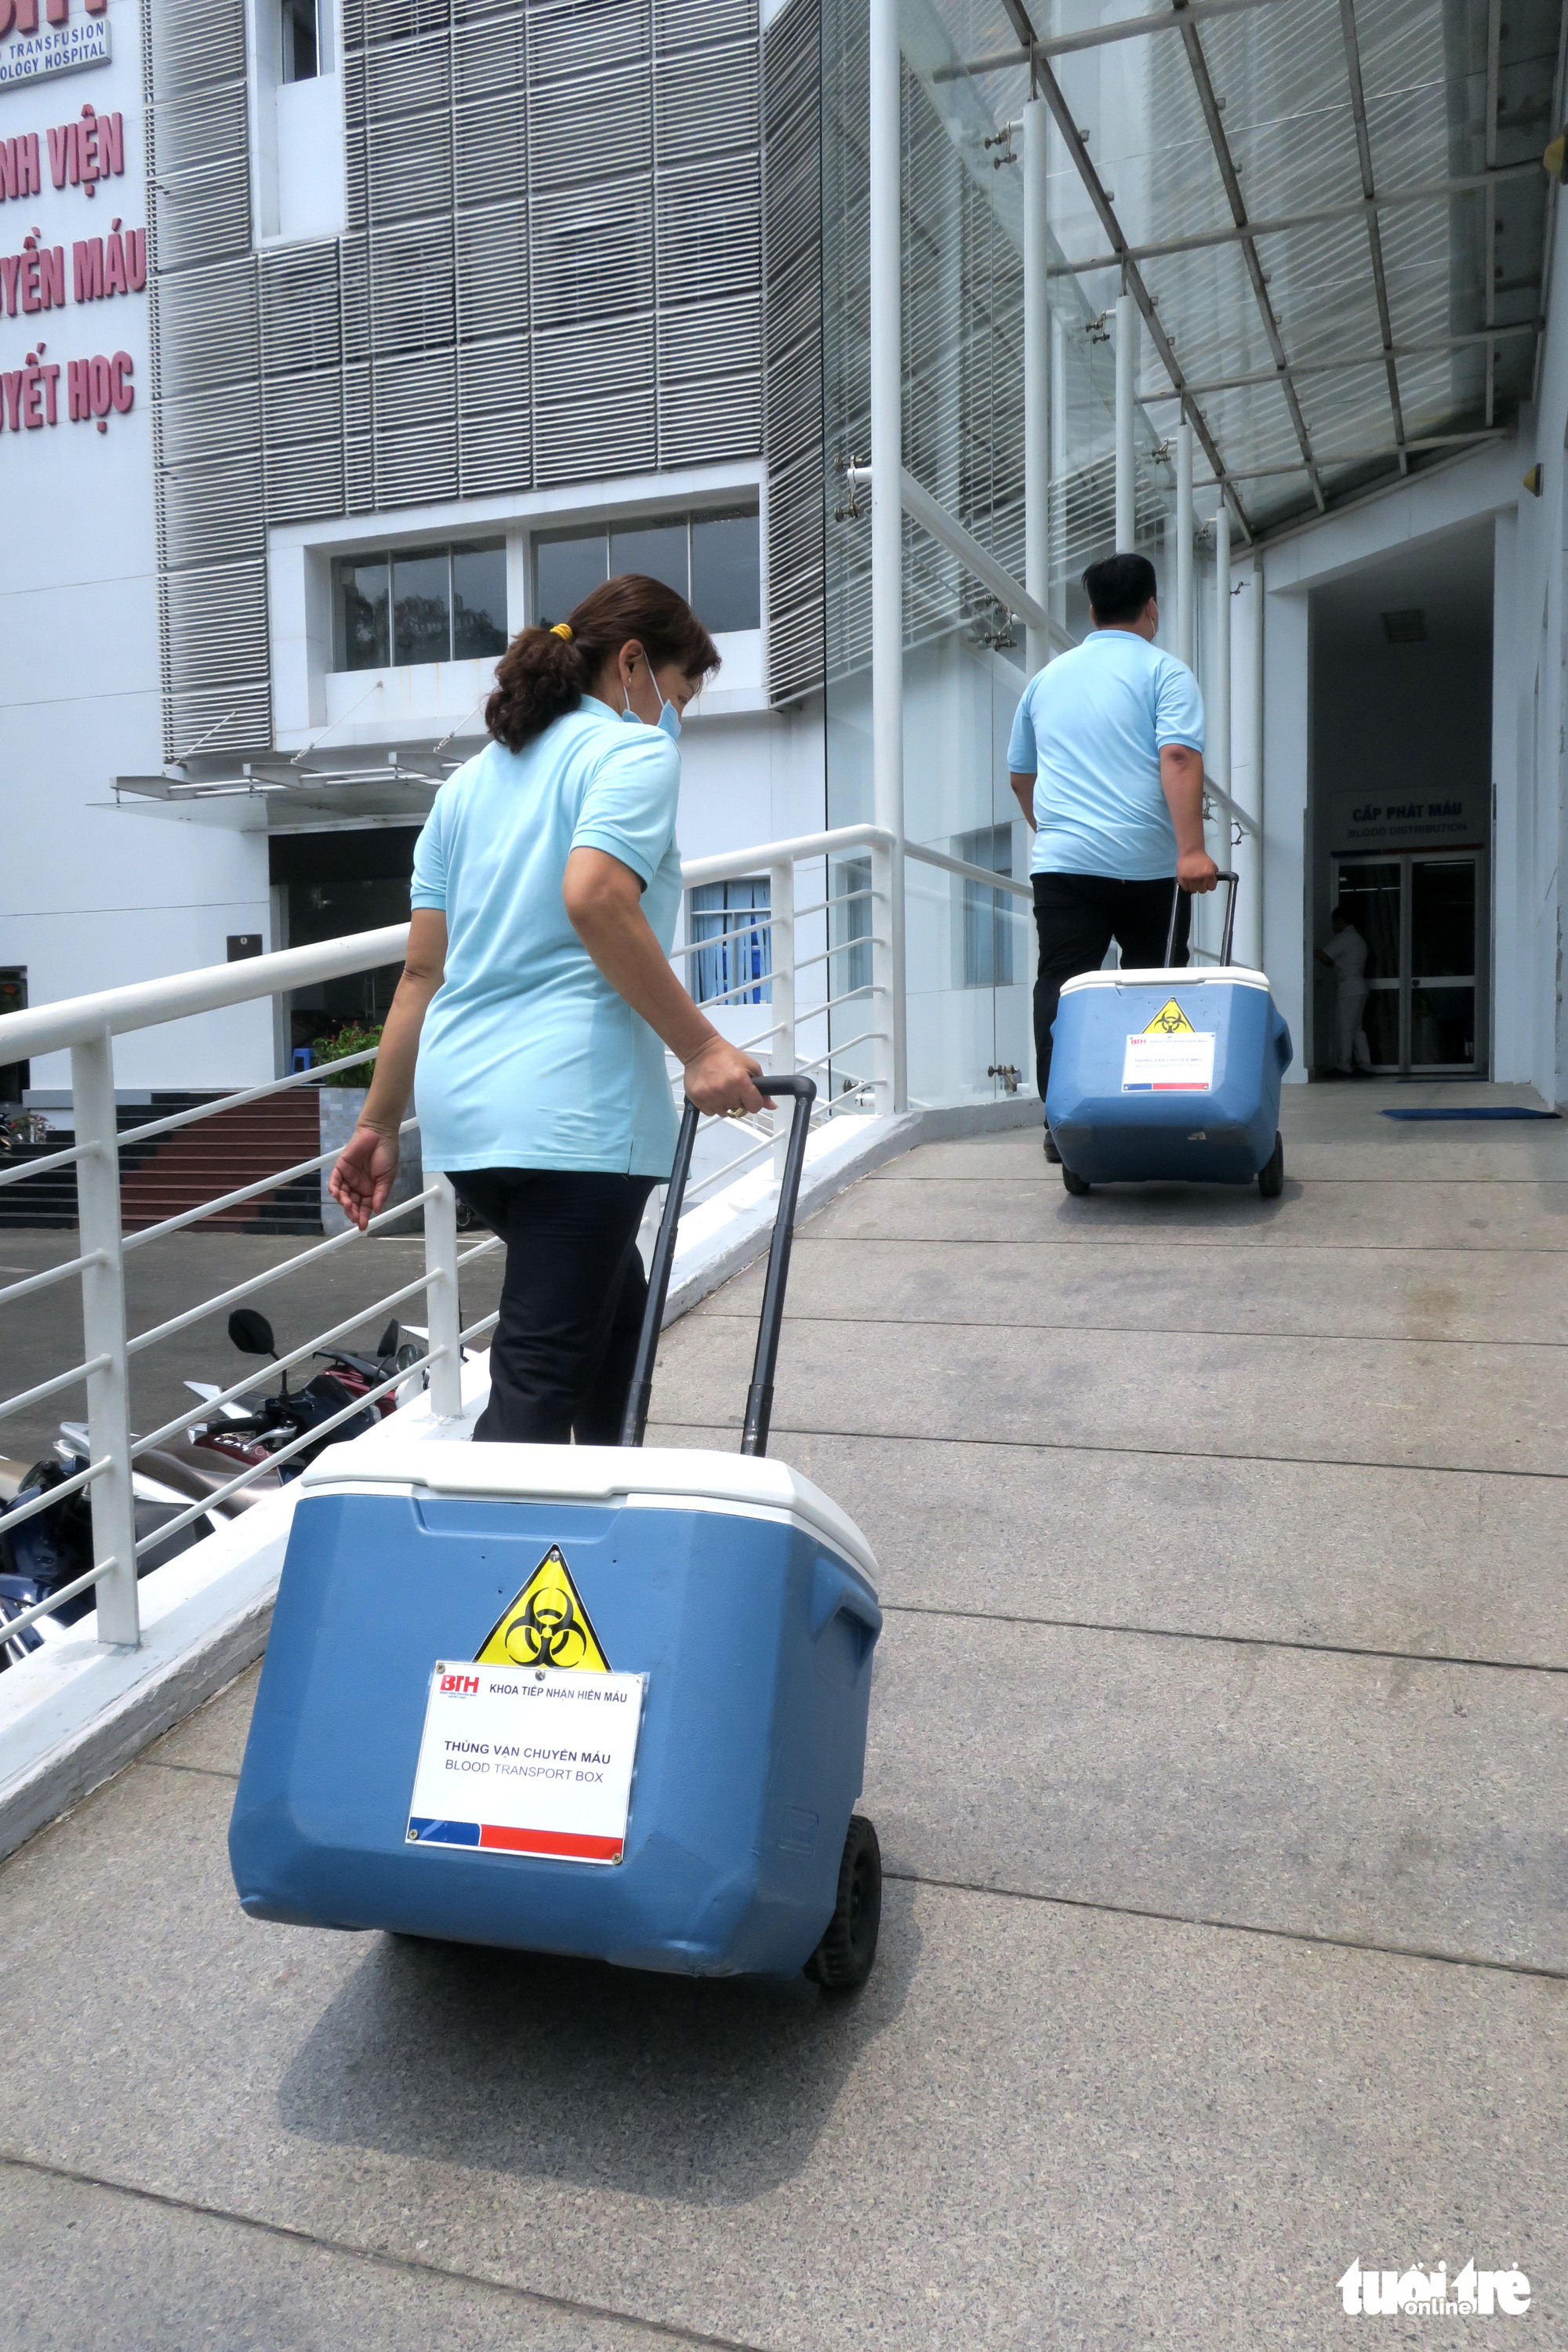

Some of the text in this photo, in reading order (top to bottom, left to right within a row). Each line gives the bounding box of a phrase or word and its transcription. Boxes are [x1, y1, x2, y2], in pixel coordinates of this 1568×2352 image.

[9, 21, 105, 60] TRANSFUSION
[45, 42, 106, 69] HOSPITAL
[46, 103, 125, 198] VIỆN
[72, 216, 147, 303] MÁU
[0, 342, 135, 434] YẾT HỌC
[1352, 800, 1462, 822] CẤP PHÁT MÁU
[1348, 822, 1468, 838] BLOOD DISTRIBUTION
[440, 1675, 480, 1693] BTH
[489, 1683, 519, 1695] KHOA
[521, 1684, 543, 1697] TIẾP
[603, 1690, 628, 1703] MÁU
[445, 1739, 490, 1755] THÙNG
[580, 1751, 612, 1765] MÁU
[445, 1759, 604, 1784] BLOOD TRANSPORT BOX
